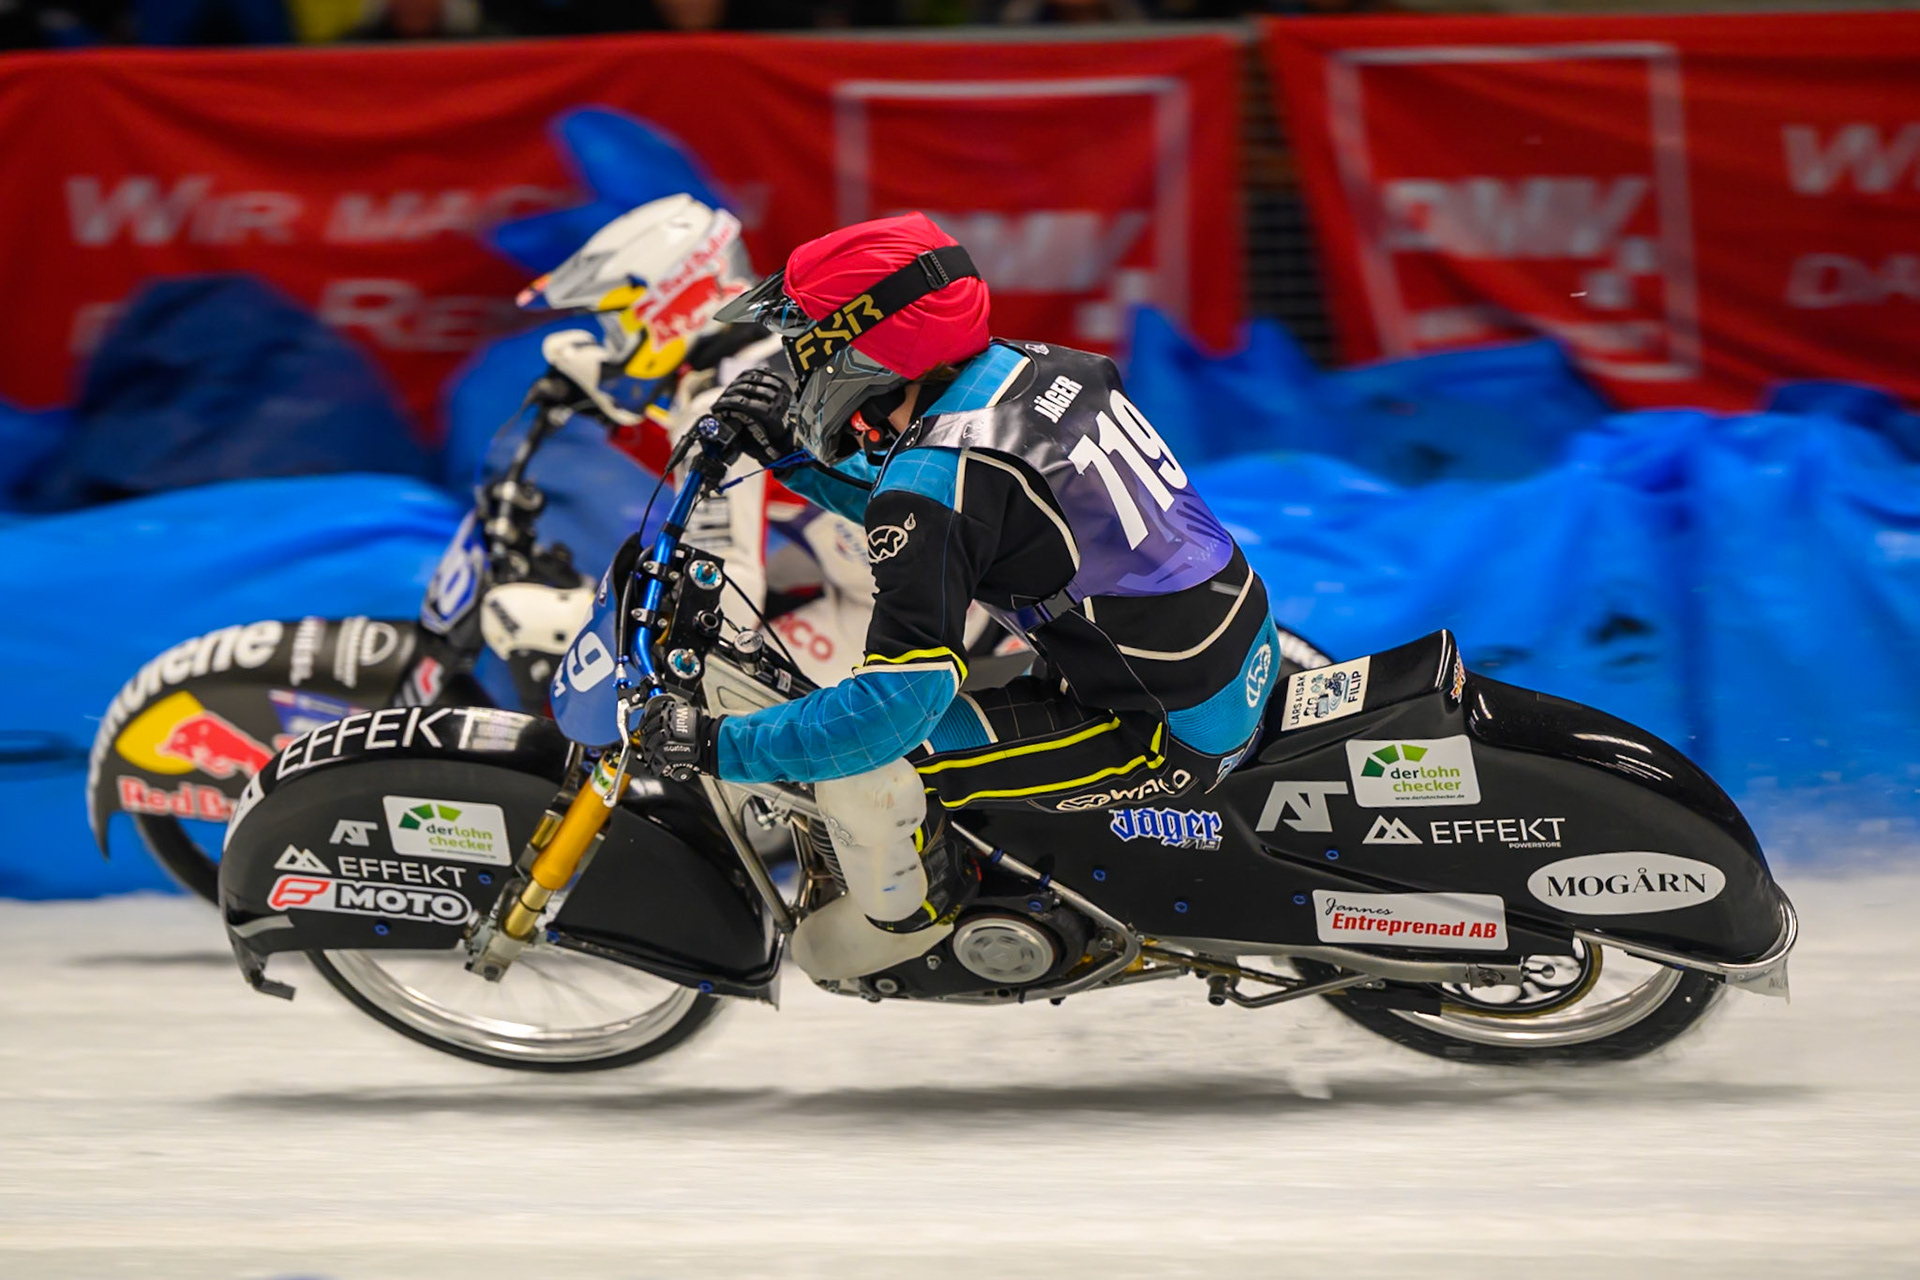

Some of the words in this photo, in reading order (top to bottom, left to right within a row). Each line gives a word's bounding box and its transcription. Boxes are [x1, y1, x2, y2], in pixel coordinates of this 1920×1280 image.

[795, 294, 884, 370] FXR
[1033, 375, 1083, 424] JÄGER
[1067, 389, 1188, 551] 719
[1347, 670, 1363, 703] FILIP
[676, 707, 689, 733] Wulf
[1290, 702, 1304, 726] LARS
[276, 707, 493, 780] EFFEKT
[1390, 765, 1461, 780] derlohn
[1393, 780, 1463, 793] checker
[117, 775, 194, 820] Red
[428, 835, 494, 852] checker
[1430, 817, 1566, 845] EFFEKT
[1509, 841, 1562, 849] POWERSTORE
[337, 856, 467, 888] EFFEKT
[1547, 866, 1706, 897] MOGÅRN
[339, 886, 464, 921] MOTO
[1325, 897, 1393, 915] Jannes
[1332, 913, 1465, 937] Entreprenad
[1469, 922, 1497, 938] AB
